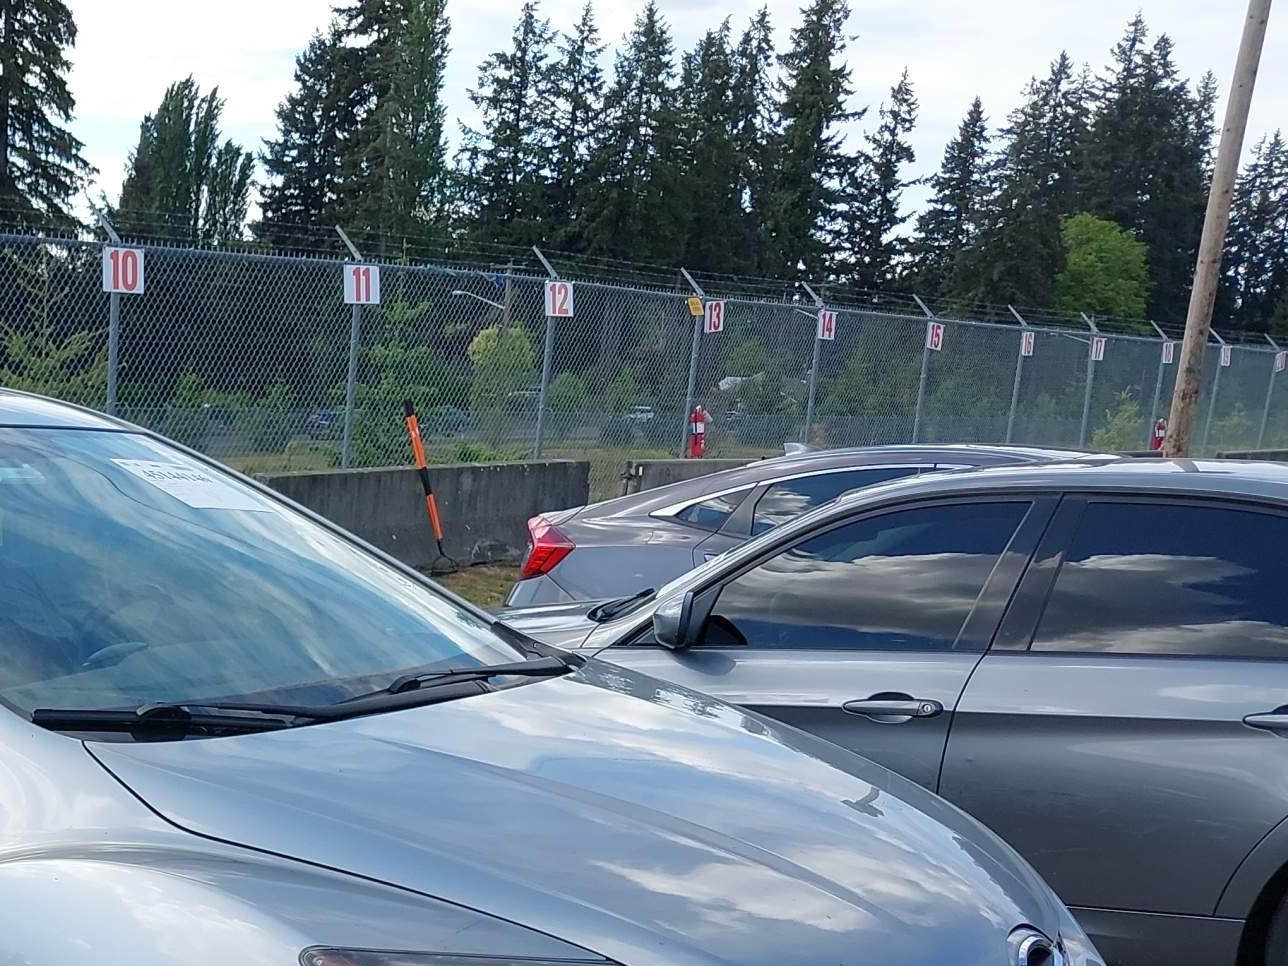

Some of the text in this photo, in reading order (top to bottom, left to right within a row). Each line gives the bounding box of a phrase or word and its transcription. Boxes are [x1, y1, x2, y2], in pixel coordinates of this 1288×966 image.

[110, 249, 139, 292] 10
[352, 266, 372, 303] 11
[549, 283, 569, 316] 12
[708, 302, 723, 332] 13
[821, 312, 834, 338] 14
[930, 323, 943, 349] 15
[1023, 334, 1033, 355] 16
[1094, 338, 1104, 360] 17
